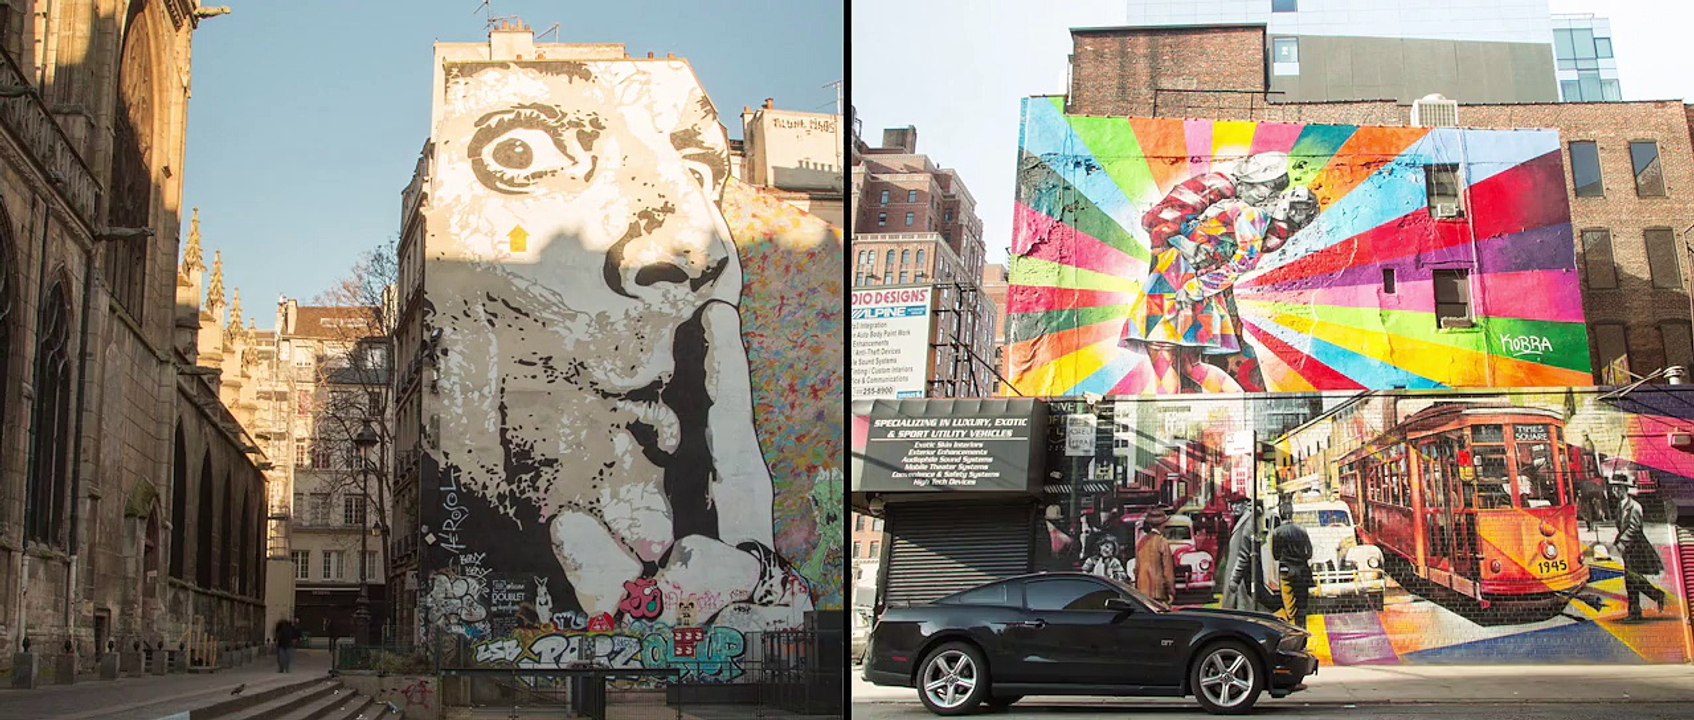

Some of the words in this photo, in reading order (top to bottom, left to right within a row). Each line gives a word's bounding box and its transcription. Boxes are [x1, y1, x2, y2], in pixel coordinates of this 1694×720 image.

[875, 289, 928, 304] DESIGNS
[858, 307, 906, 319] ALPINE
[860, 322, 887, 331] Integration
[857, 331, 869, 339] Auto
[870, 330, 883, 339] Body
[884, 329, 897, 337] Paint
[1499, 334, 1553, 353] KOBRA
[881, 347, 902, 355] Devices
[858, 357, 874, 366] Sound
[875, 357, 897, 366] Systems
[871, 366, 890, 374] Custom
[866, 375, 909, 384] Communications
[874, 418, 937, 428] SPECIALIZING
[939, 418, 951, 427] IN
[952, 418, 992, 428] LUXURY,
[994, 418, 1028, 426] EXOTIC
[887, 430, 895, 438] &
[897, 430, 930, 438] SPORT
[930, 430, 968, 438] UTILITY
[969, 429, 1013, 438] VEHICLES
[1515, 433, 1548, 441] SQUARE
[901, 456, 938, 464] Audiophile
[963, 456, 993, 464] Systems
[957, 463, 989, 471] Systems
[943, 471, 967, 479] Safety
[968, 471, 1000, 479] Systems
[913, 479, 930, 487] High
[1538, 559, 1567, 574] 1945
[492, 592, 525, 601] DOUBLET
